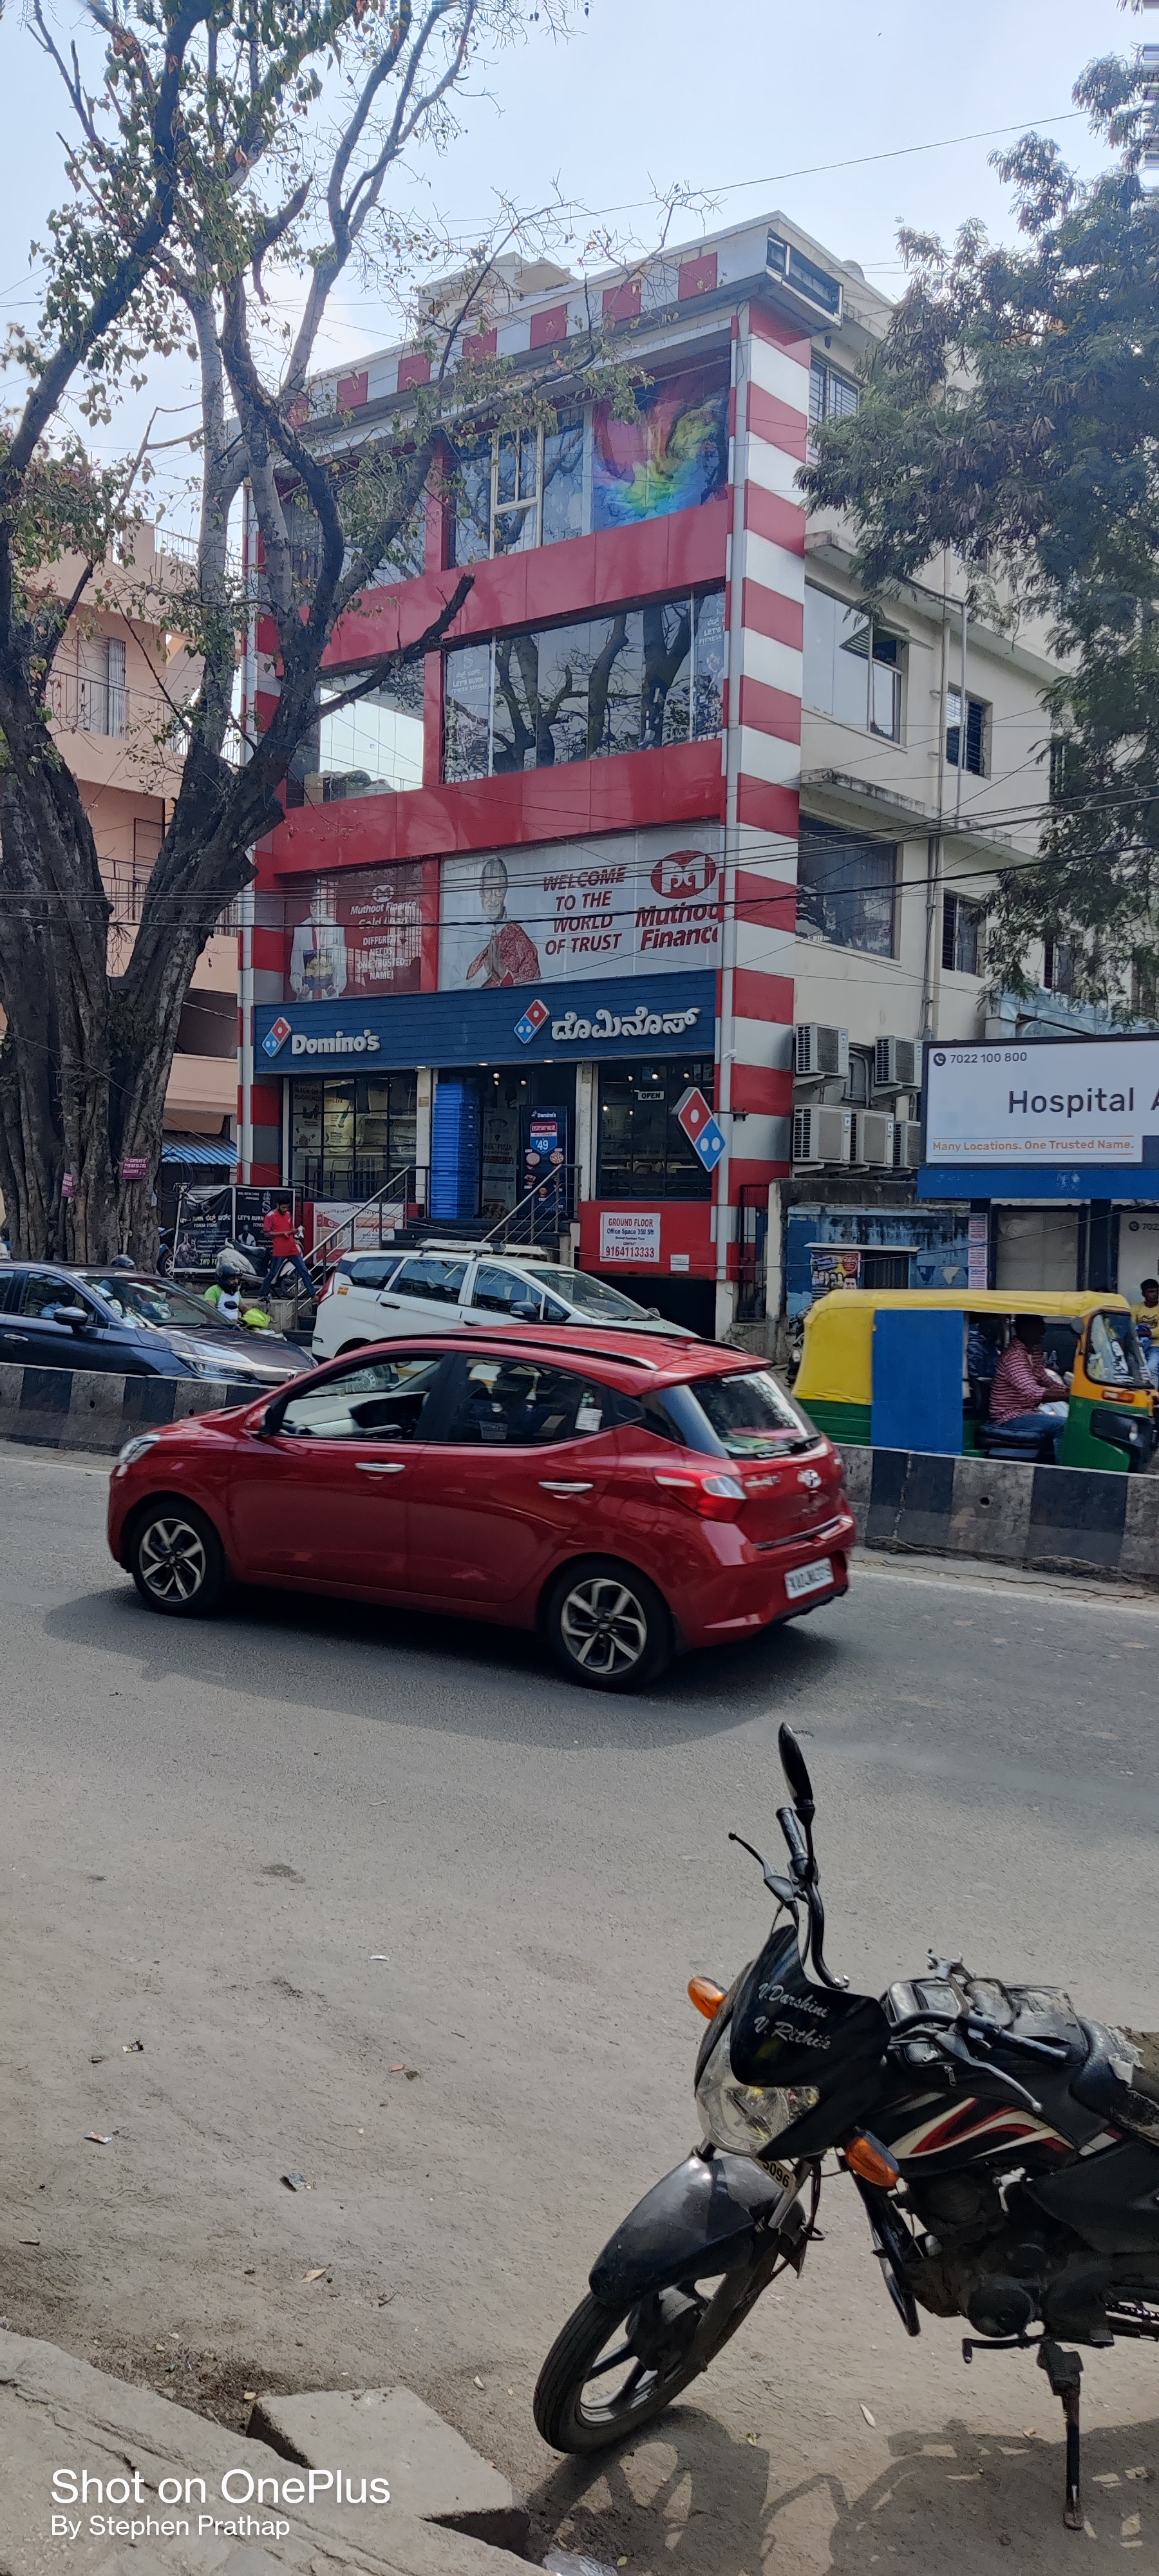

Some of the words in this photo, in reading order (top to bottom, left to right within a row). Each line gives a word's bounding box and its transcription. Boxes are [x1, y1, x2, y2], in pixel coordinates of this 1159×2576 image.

[543, 866, 627, 892] WELCOME
[350, 903, 384, 915] Muthoot
[556, 895, 576, 911] TO
[582, 891, 612, 909] THE
[554, 913, 613, 933] WORLD
[363, 934, 400, 946] DIFFERENT
[545, 938, 566, 955] OF
[570, 933, 622, 953] TRUST
[292, 1029, 380, 1055] Domino's
[950, 1054, 977, 1063] 7022
[981, 1053, 1001, 1063] 100
[1004, 1052, 1027, 1062] 800
[1008, 1087, 1134, 1118] Hospital
[933, 1142, 961, 1153] Many
[963, 1141, 1022, 1151] Locations.
[1024, 1141, 1046, 1150] One
[1049, 1139, 1094, 1149] Trusted
[1097, 1139, 1135, 1149] Name.
[608, 1218, 632, 1227] GROUND
[634, 1218, 654, 1227] FLOOR
[605, 1245, 655, 1258] 9164113333
